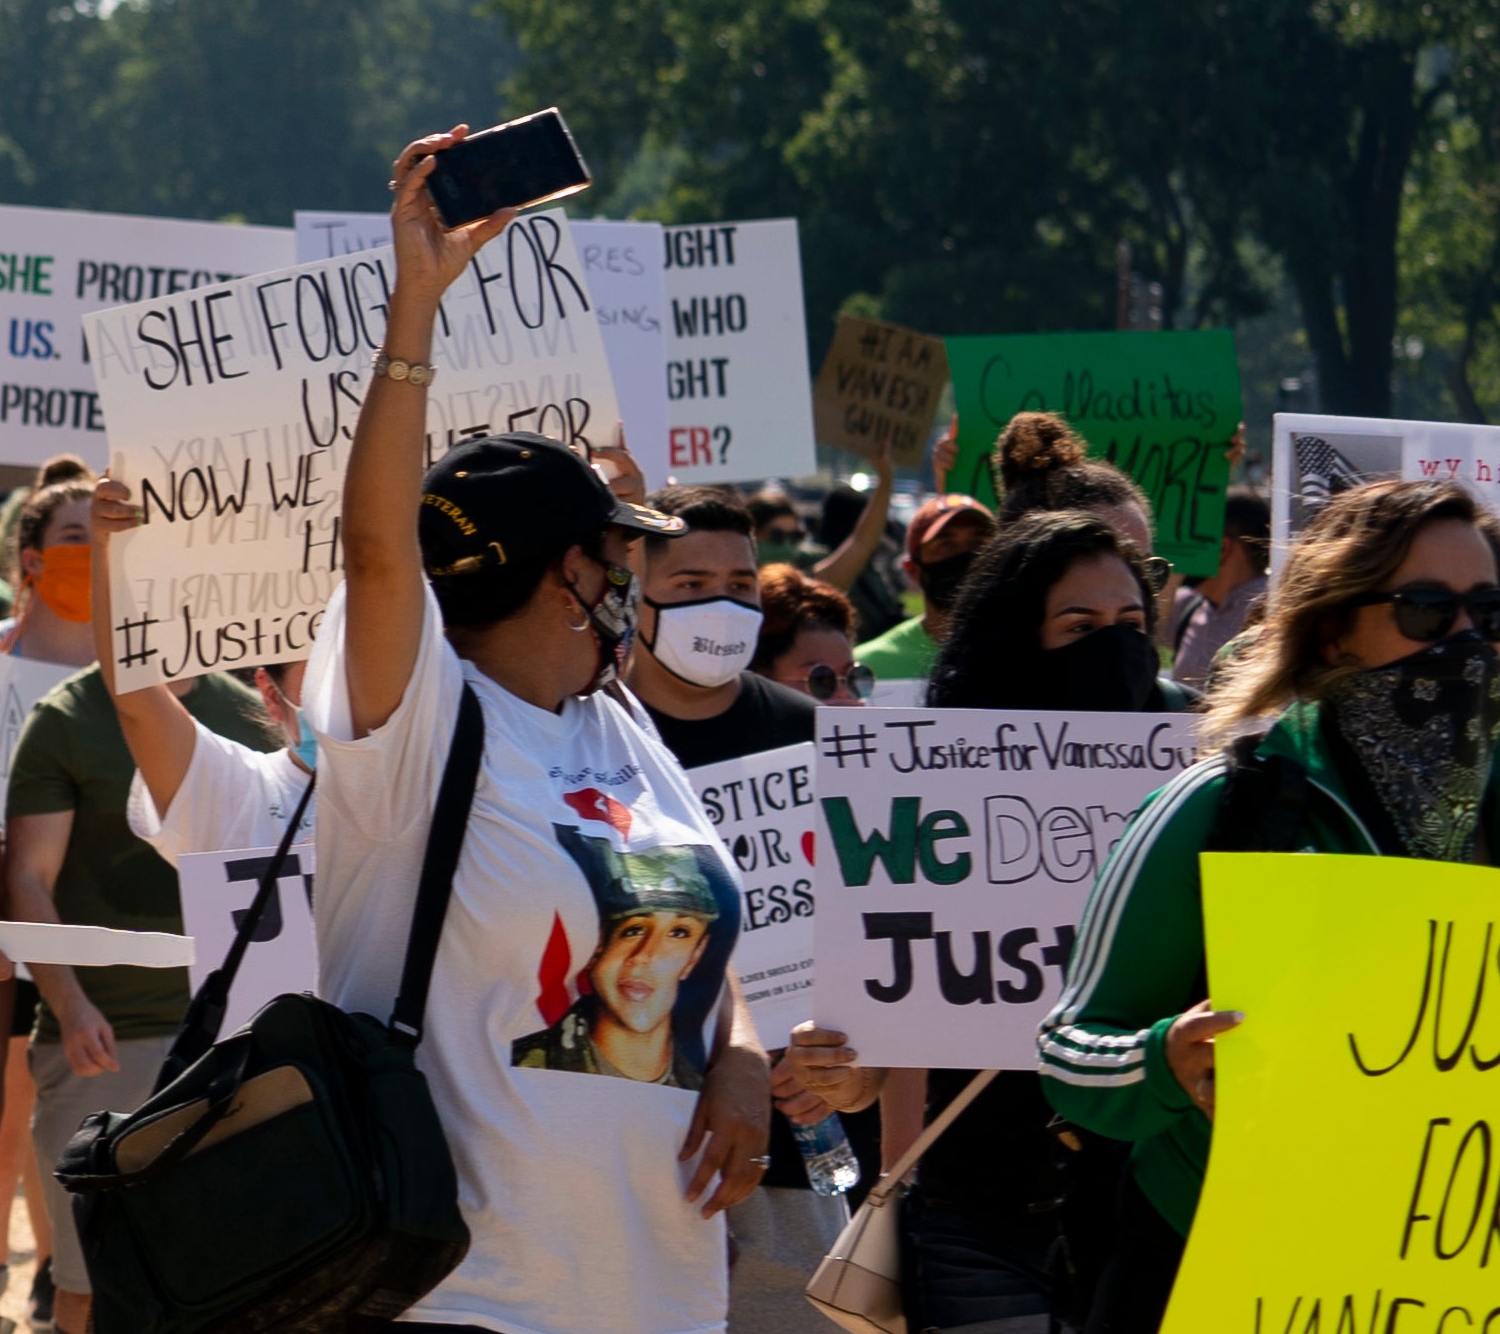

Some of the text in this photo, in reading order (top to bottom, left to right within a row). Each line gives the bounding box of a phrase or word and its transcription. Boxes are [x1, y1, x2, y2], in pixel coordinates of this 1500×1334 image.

[76, 259, 248, 304] PROTE
[8, 319, 61, 362] US.
[138, 290, 249, 390] SHE
[256, 259, 451, 370] FOUG
[673, 293, 748, 339] WHO
[302, 370, 362, 448] US
[669, 425, 732, 468] ER?
[141, 458, 252, 525] NOW
[266, 449, 326, 510] WE
[701, 764, 815, 826] STICE
[819, 795, 972, 887] We
